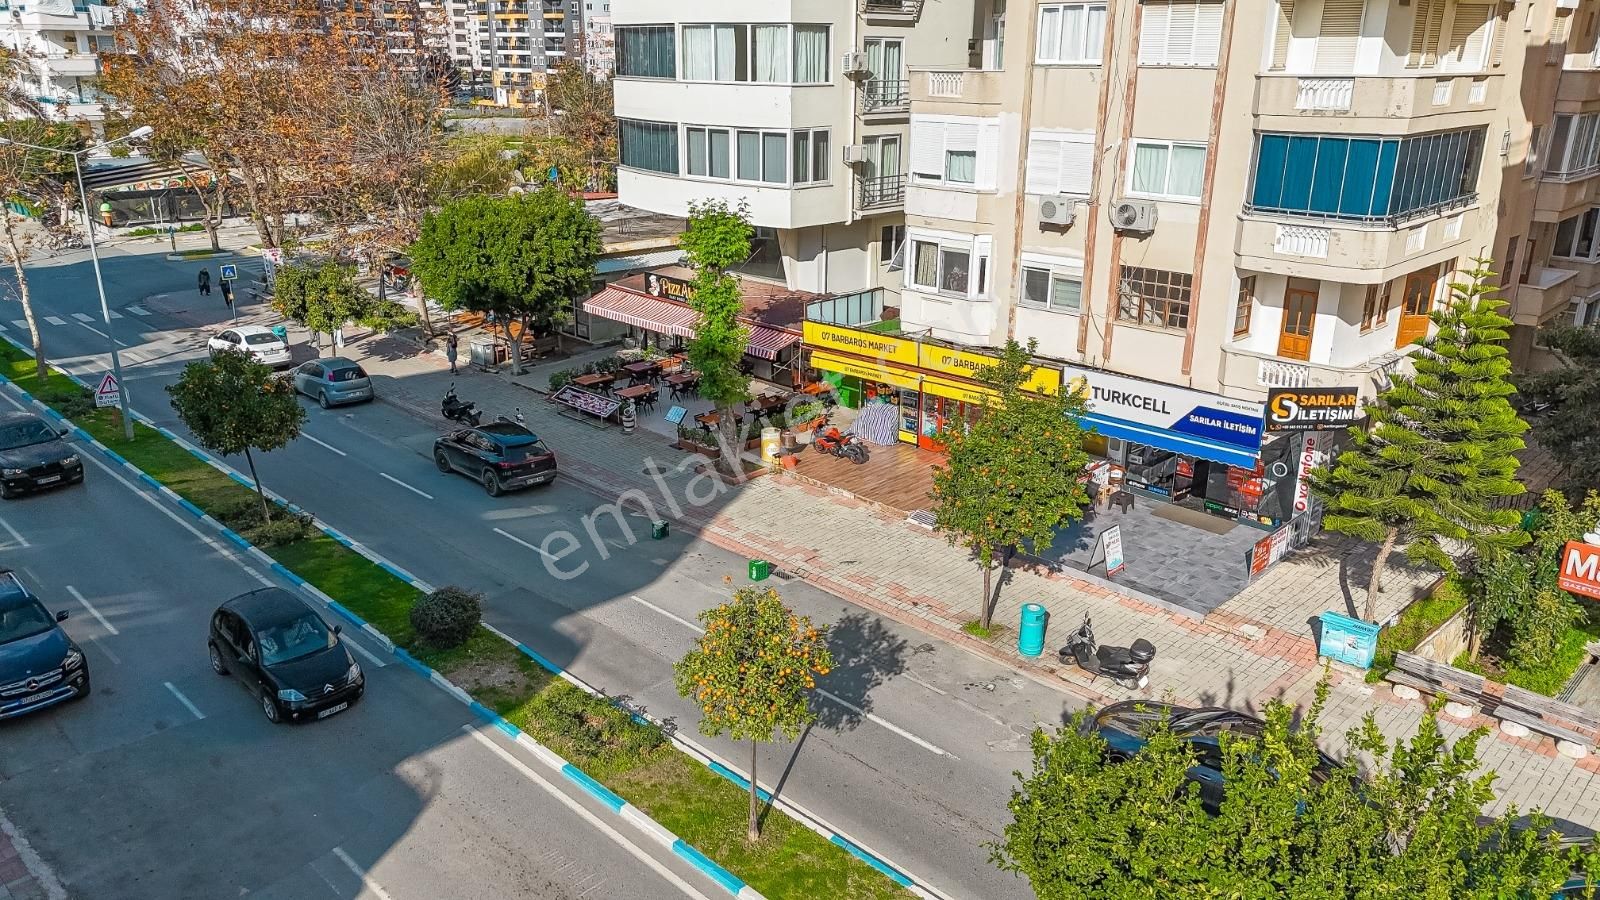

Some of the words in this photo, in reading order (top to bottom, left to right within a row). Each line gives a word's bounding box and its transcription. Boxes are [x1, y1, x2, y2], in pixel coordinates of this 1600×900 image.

[821, 331, 831, 341] 07
[831, 333, 867, 349] BARBAROS
[868, 341, 897, 354] MARKET
[942, 355, 952, 366] 07
[1091, 386, 1171, 415] TURKCELL
[1299, 394, 1356, 406] SARILAR
[1189, 414, 1222, 428] SARILAR
[1223, 419, 1257, 435] İLETİŞİM
[1297, 406, 1353, 422] İLETİŞİM
[1565, 548, 1600, 583] M
